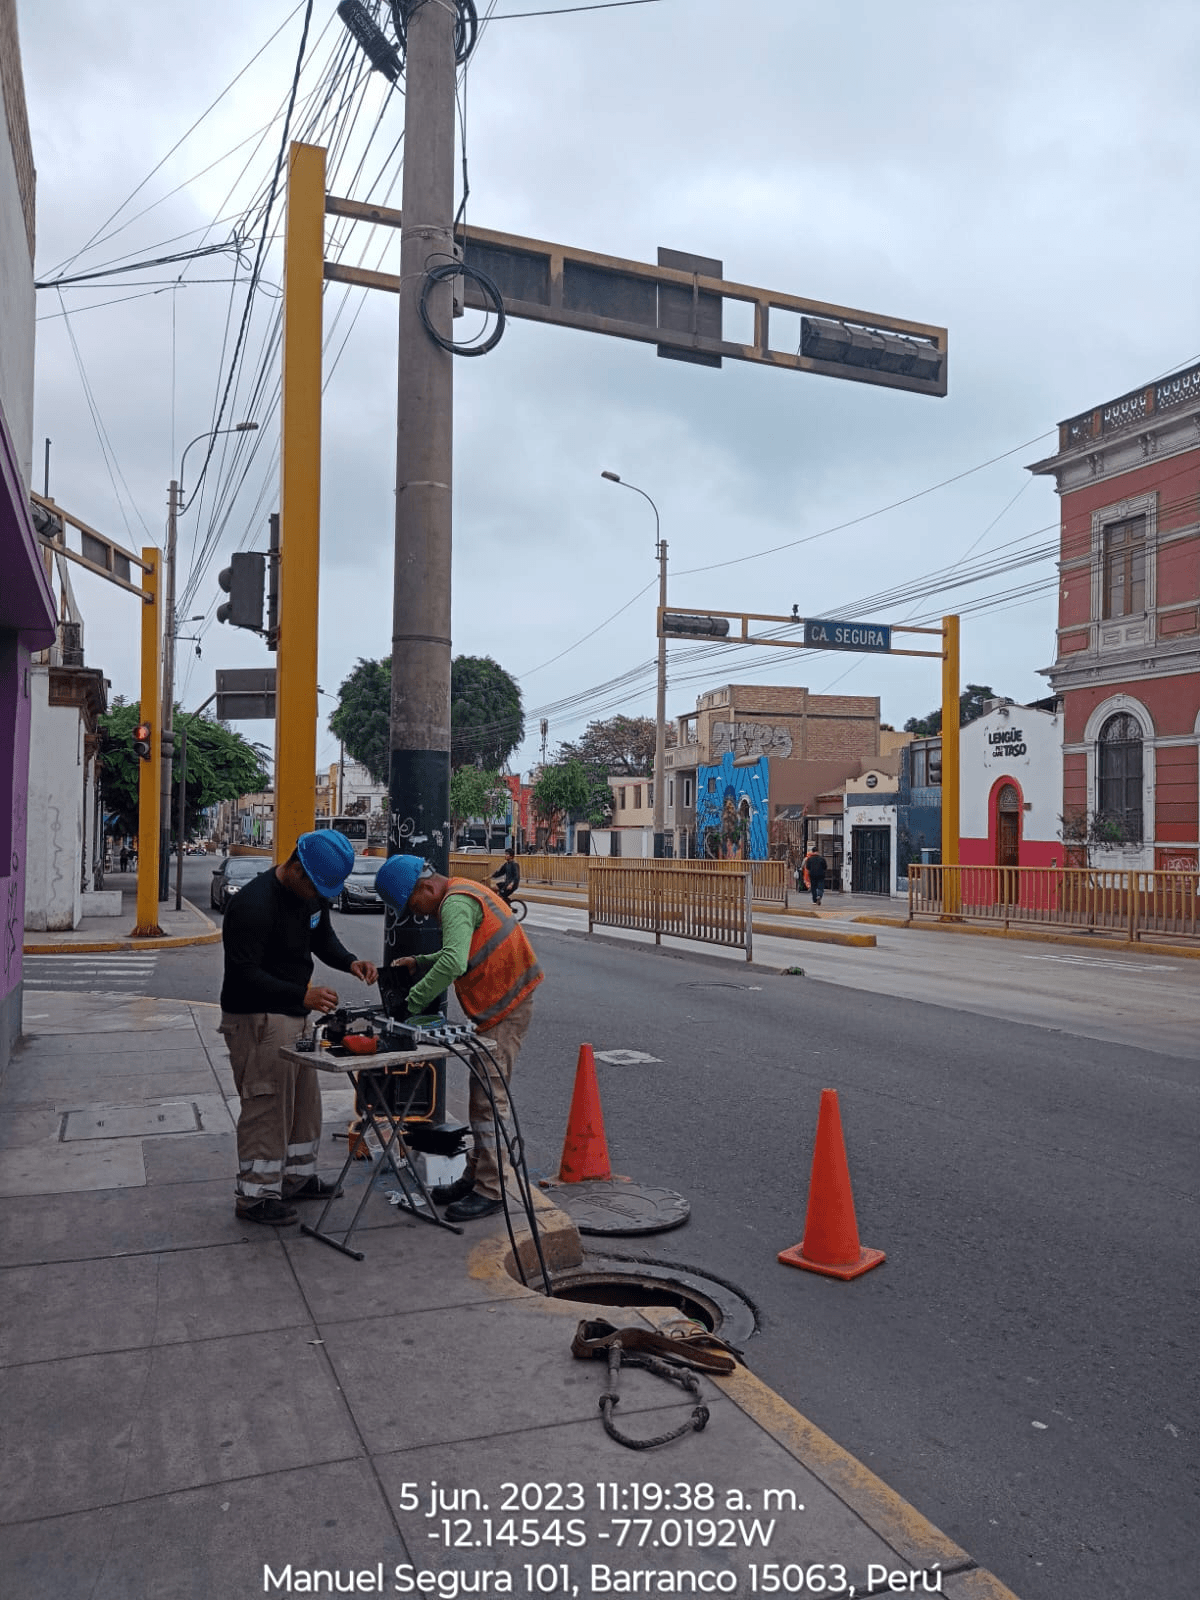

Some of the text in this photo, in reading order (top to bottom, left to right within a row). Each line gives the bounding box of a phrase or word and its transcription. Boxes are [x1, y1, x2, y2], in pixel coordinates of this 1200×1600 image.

[835, 628, 884, 646] SEGURA
[988, 727, 1023, 744] LENGÜE
[1004, 743, 1027, 757] TASO
